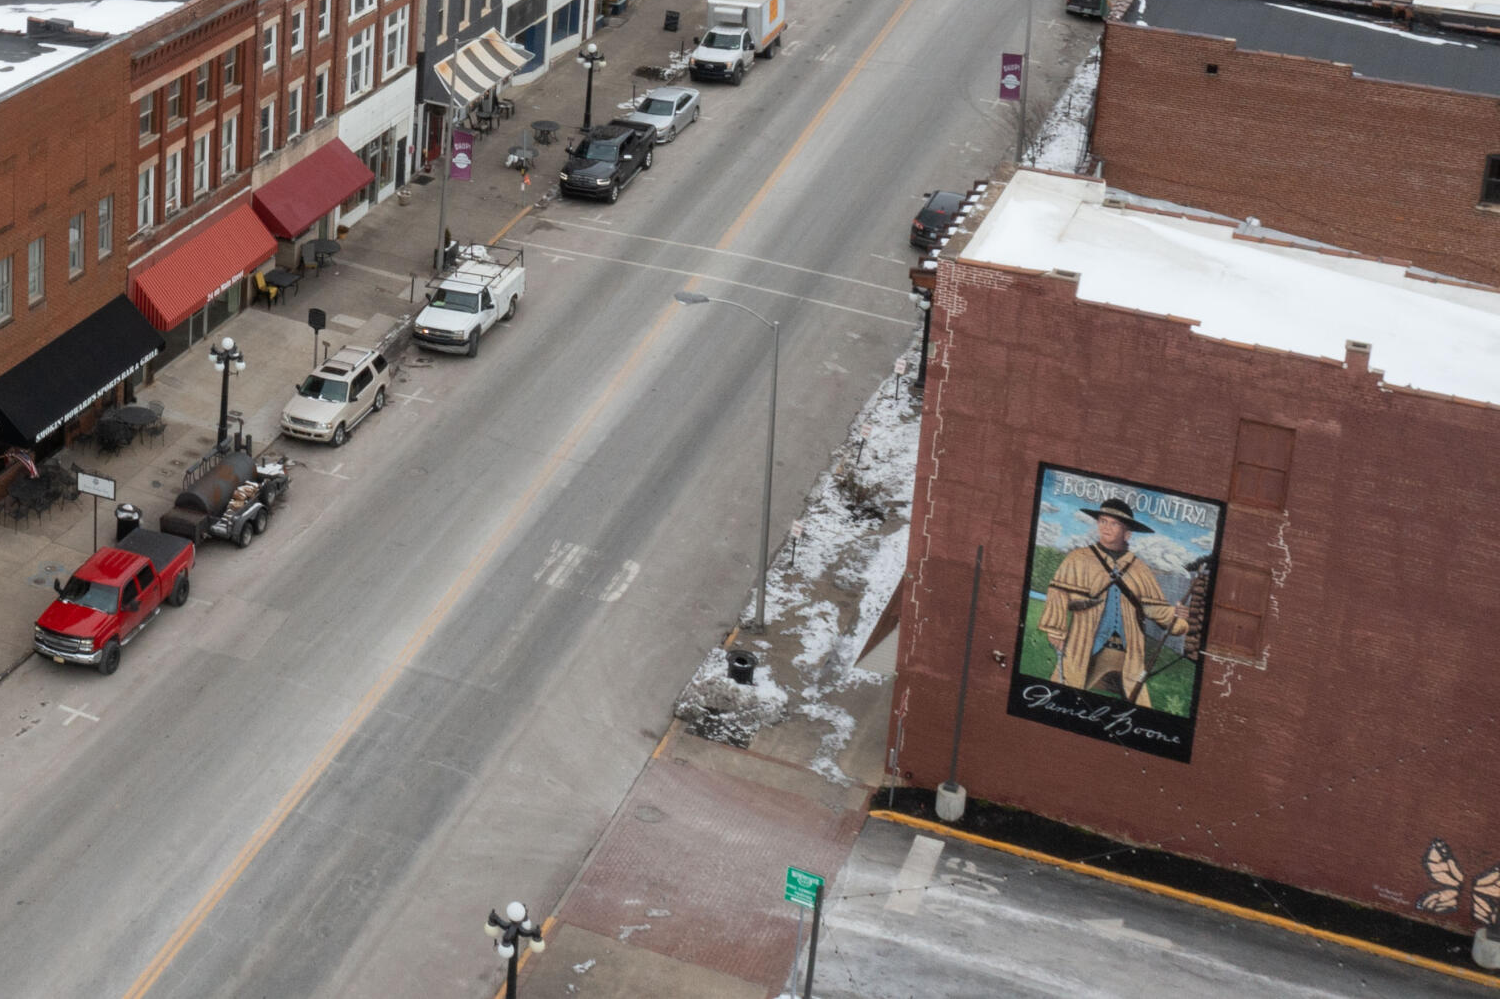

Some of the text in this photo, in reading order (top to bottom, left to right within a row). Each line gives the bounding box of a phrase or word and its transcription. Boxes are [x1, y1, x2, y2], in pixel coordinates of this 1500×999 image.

[97, 375, 121, 397] SPORTS
[121, 365, 134, 381] BAR
[140, 347, 158, 366] GRILL
[1062, 476, 1122, 500] BOONE
[1124, 490, 1206, 527] COUNTRY!
[1022, 684, 1181, 744] Daniel Boone
